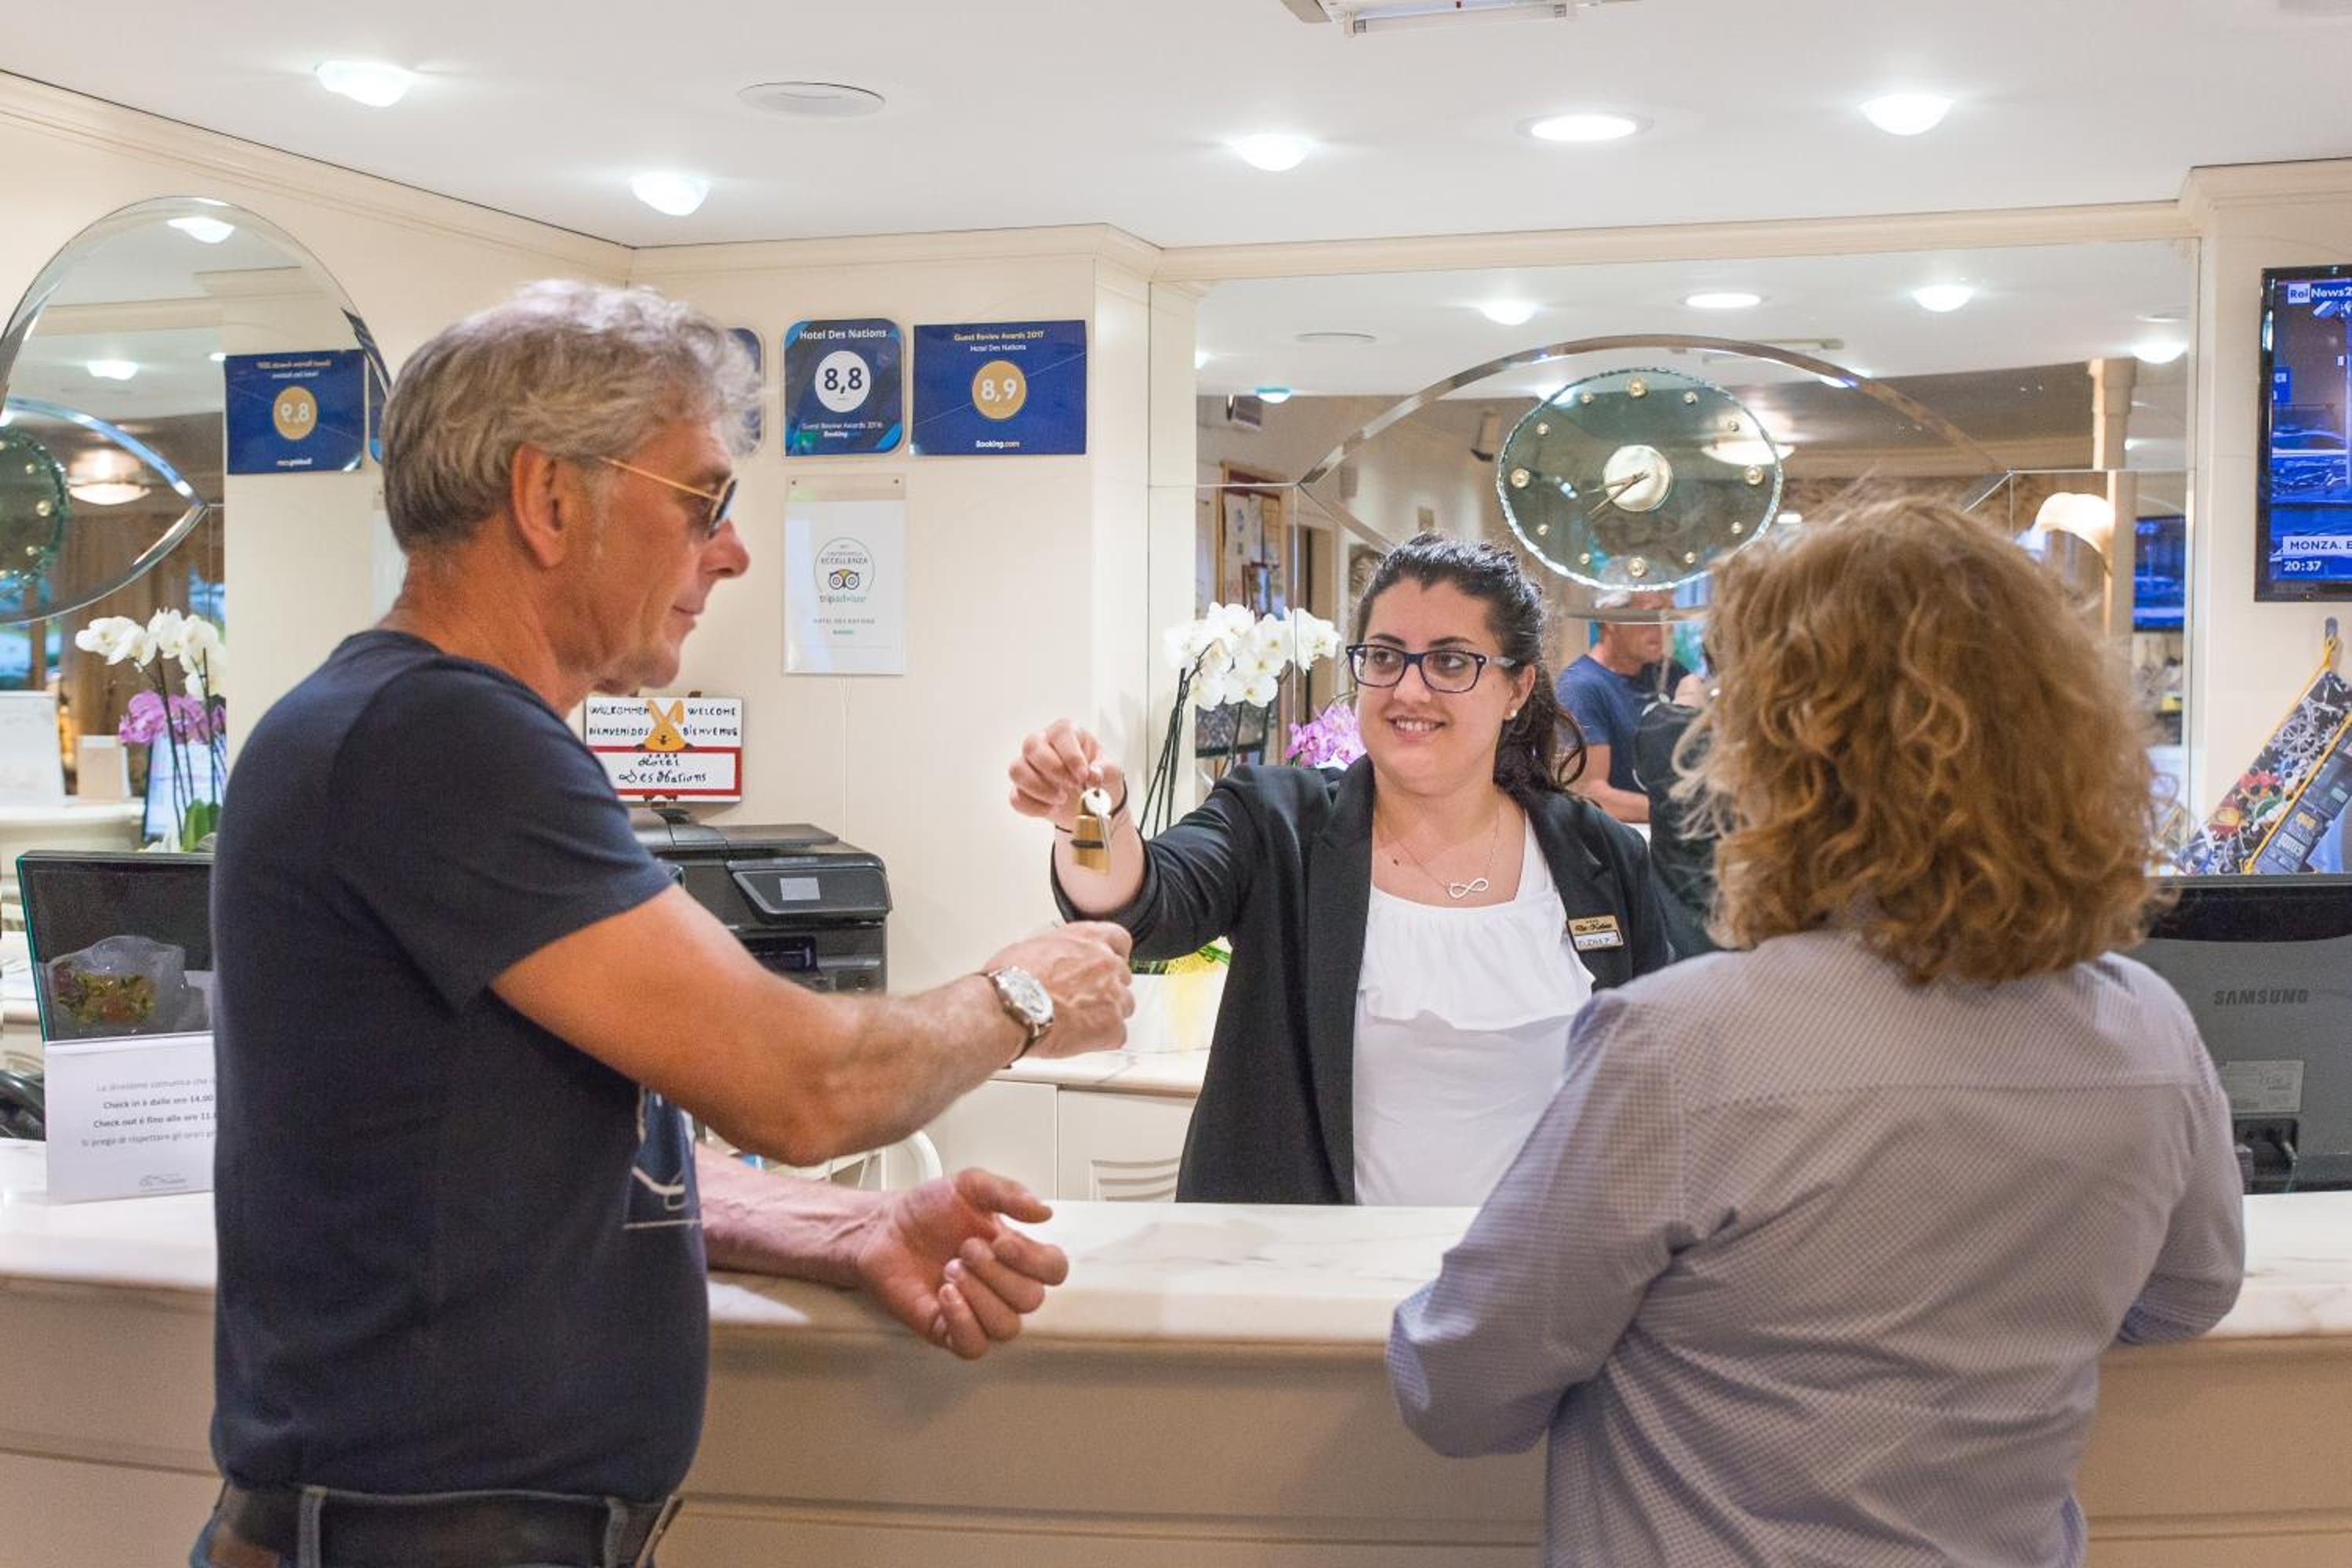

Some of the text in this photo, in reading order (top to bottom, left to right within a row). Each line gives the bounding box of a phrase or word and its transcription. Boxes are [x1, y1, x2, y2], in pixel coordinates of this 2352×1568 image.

[2290, 289, 2309, 299] Rai
[800, 328, 887, 339] Hotel Des Nations
[824, 367, 862, 394] 8,8
[981, 379, 1017, 401] 8,9
[975, 440, 1020, 448] Booking.com
[2290, 541, 2342, 550] MONZA.
[2284, 561, 2321, 572] 20:37
[688, 707, 736, 716] WELCOME
[2213, 989, 2309, 1004] SAMSUNG
[103, 1100, 129, 1109] Check
[93, 1119, 119, 1128] Check
[122, 1117, 137, 1126] out
[147, 1115, 164, 1124] fino
